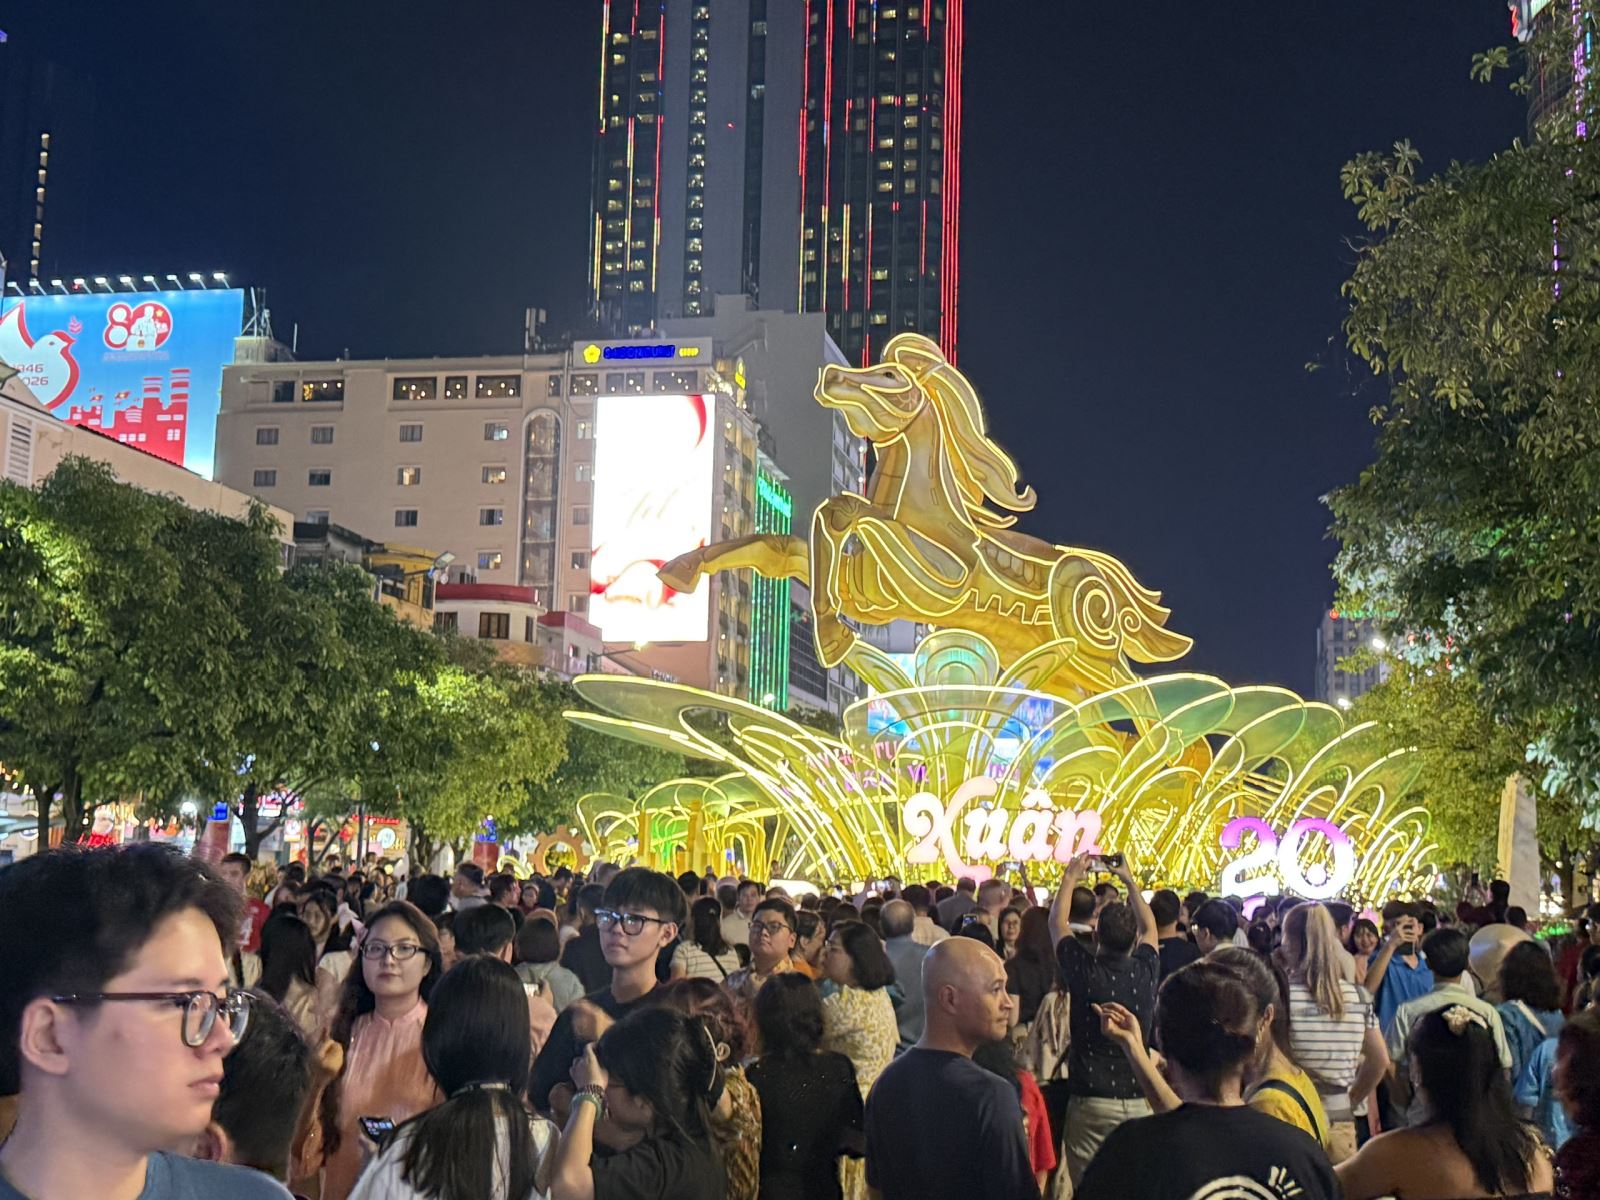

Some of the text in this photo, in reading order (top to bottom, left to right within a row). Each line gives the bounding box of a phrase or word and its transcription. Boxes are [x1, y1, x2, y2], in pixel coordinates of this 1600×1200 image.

[22, 376, 49, 386] 026
[903, 776, 1102, 884] Xuân
[1219, 816, 1355, 900] 20
